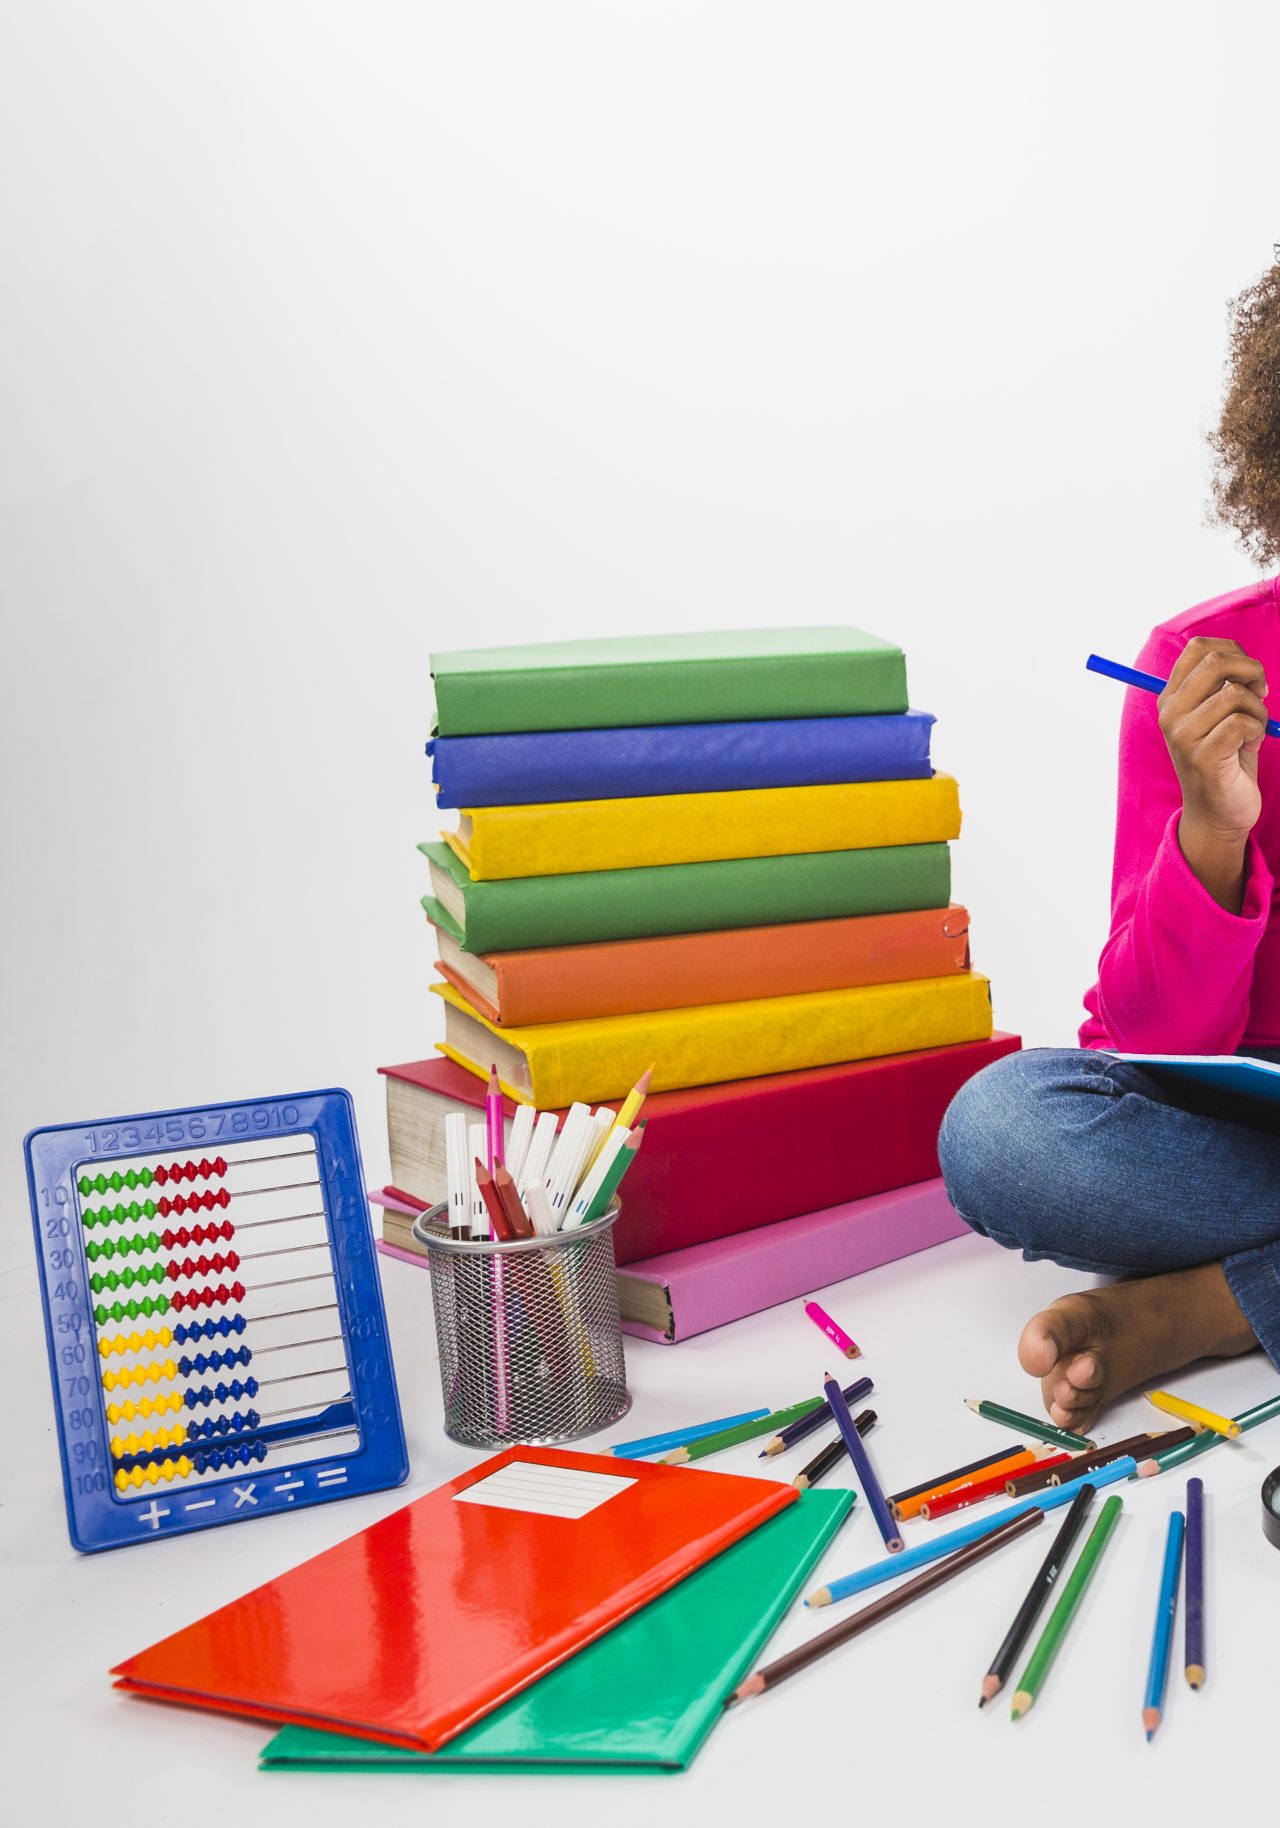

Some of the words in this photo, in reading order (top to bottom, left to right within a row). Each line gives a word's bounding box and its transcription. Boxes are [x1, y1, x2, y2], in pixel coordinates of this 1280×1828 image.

[41, 1185, 68, 1207] 10
[46, 1217, 70, 1239] 20
[50, 1248, 74, 1270] 30
[54, 1280, 78, 1301] 40
[58, 1311, 82, 1333] 50
[62, 1343, 86, 1366] 60
[65, 1375, 90, 1397] 70
[69, 1407, 94, 1430] 80
[73, 1440, 98, 1463] 90
[76, 1471, 105, 1496] 100
